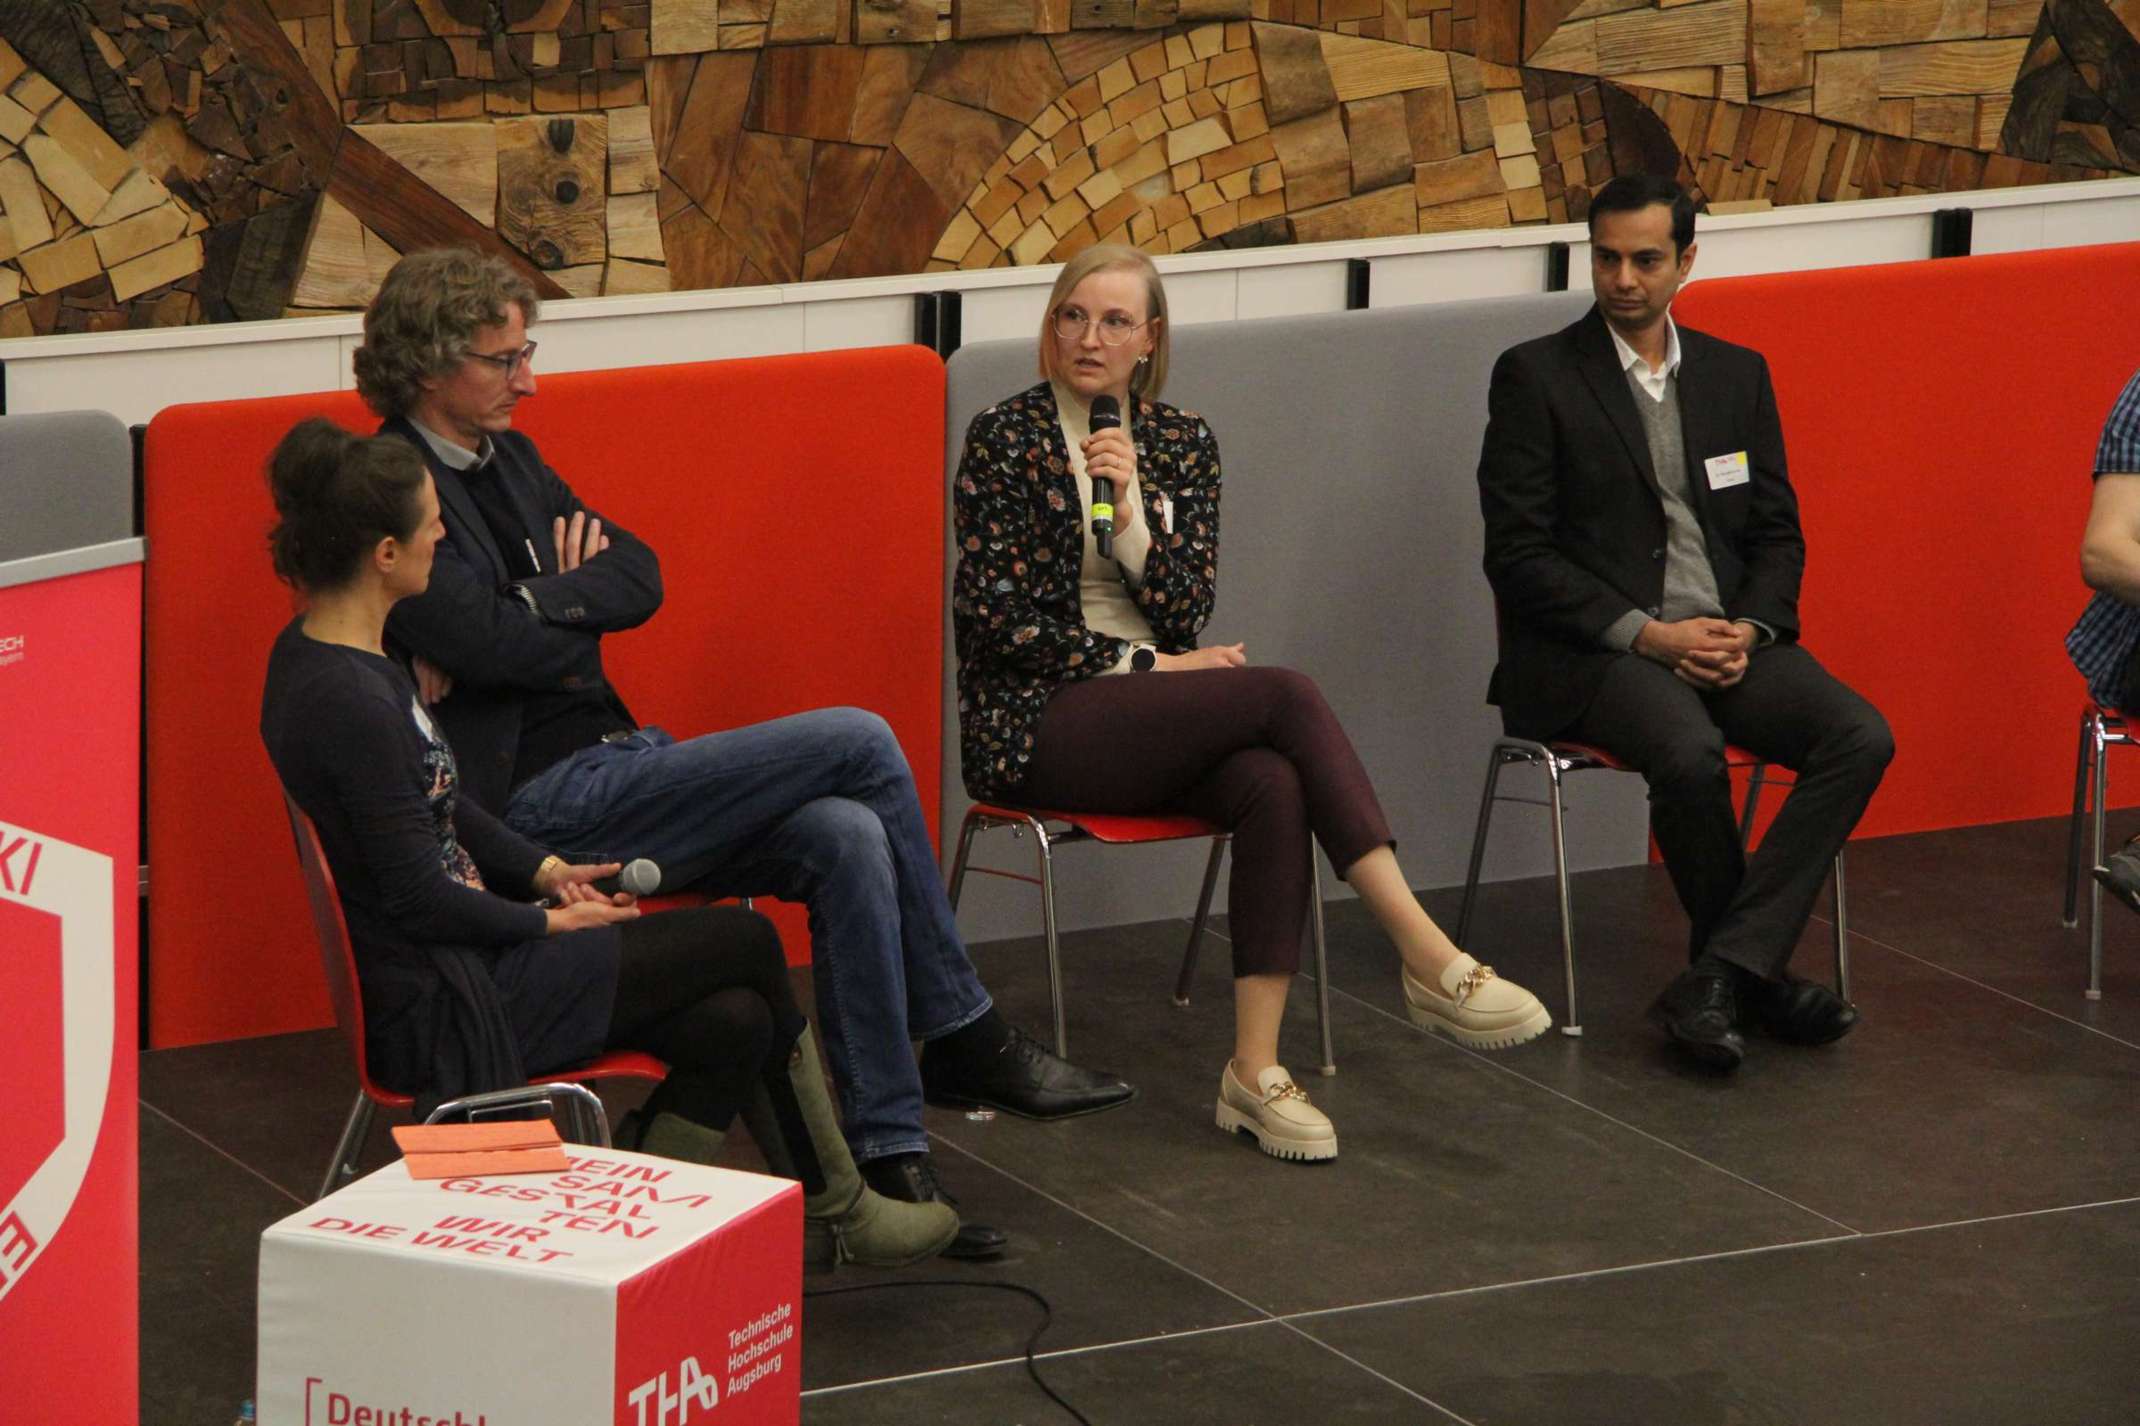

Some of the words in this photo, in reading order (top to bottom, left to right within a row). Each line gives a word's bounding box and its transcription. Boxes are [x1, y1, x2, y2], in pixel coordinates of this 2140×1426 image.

[551, 1175, 712, 1208] SAM
[308, 1217, 407, 1239] DIE
[410, 1231, 574, 1263] WELT
[433, 1215, 551, 1242] WIR
[538, 1210, 660, 1240] TEN
[728, 1303, 791, 1349] Technische
[728, 1324, 793, 1373] Hochschule
[727, 1353, 782, 1398] Augsburg
